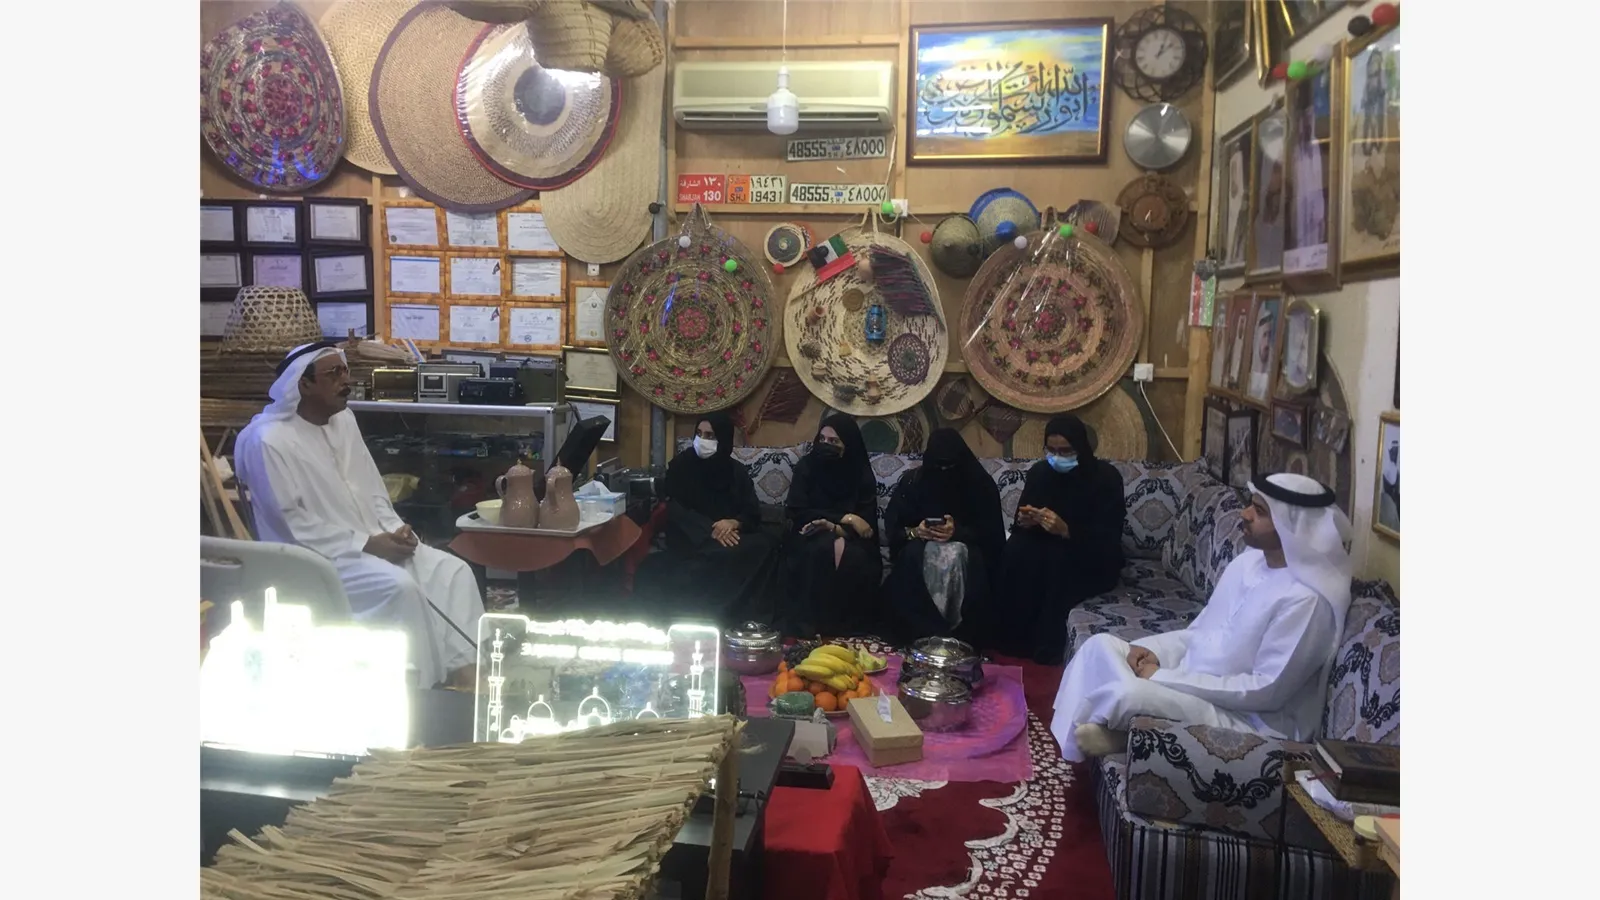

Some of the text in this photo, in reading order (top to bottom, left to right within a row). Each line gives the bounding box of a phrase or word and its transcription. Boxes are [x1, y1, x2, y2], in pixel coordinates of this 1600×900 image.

[789, 141, 827, 158] 48555
[703, 176, 721, 187] ١٣٠
[750, 176, 784, 188] ١٩٤٣١
[703, 190, 722, 202] 130
[729, 193, 747, 202] SHJ
[750, 191, 783, 203] 19431
[792, 185, 830, 202] 48555
